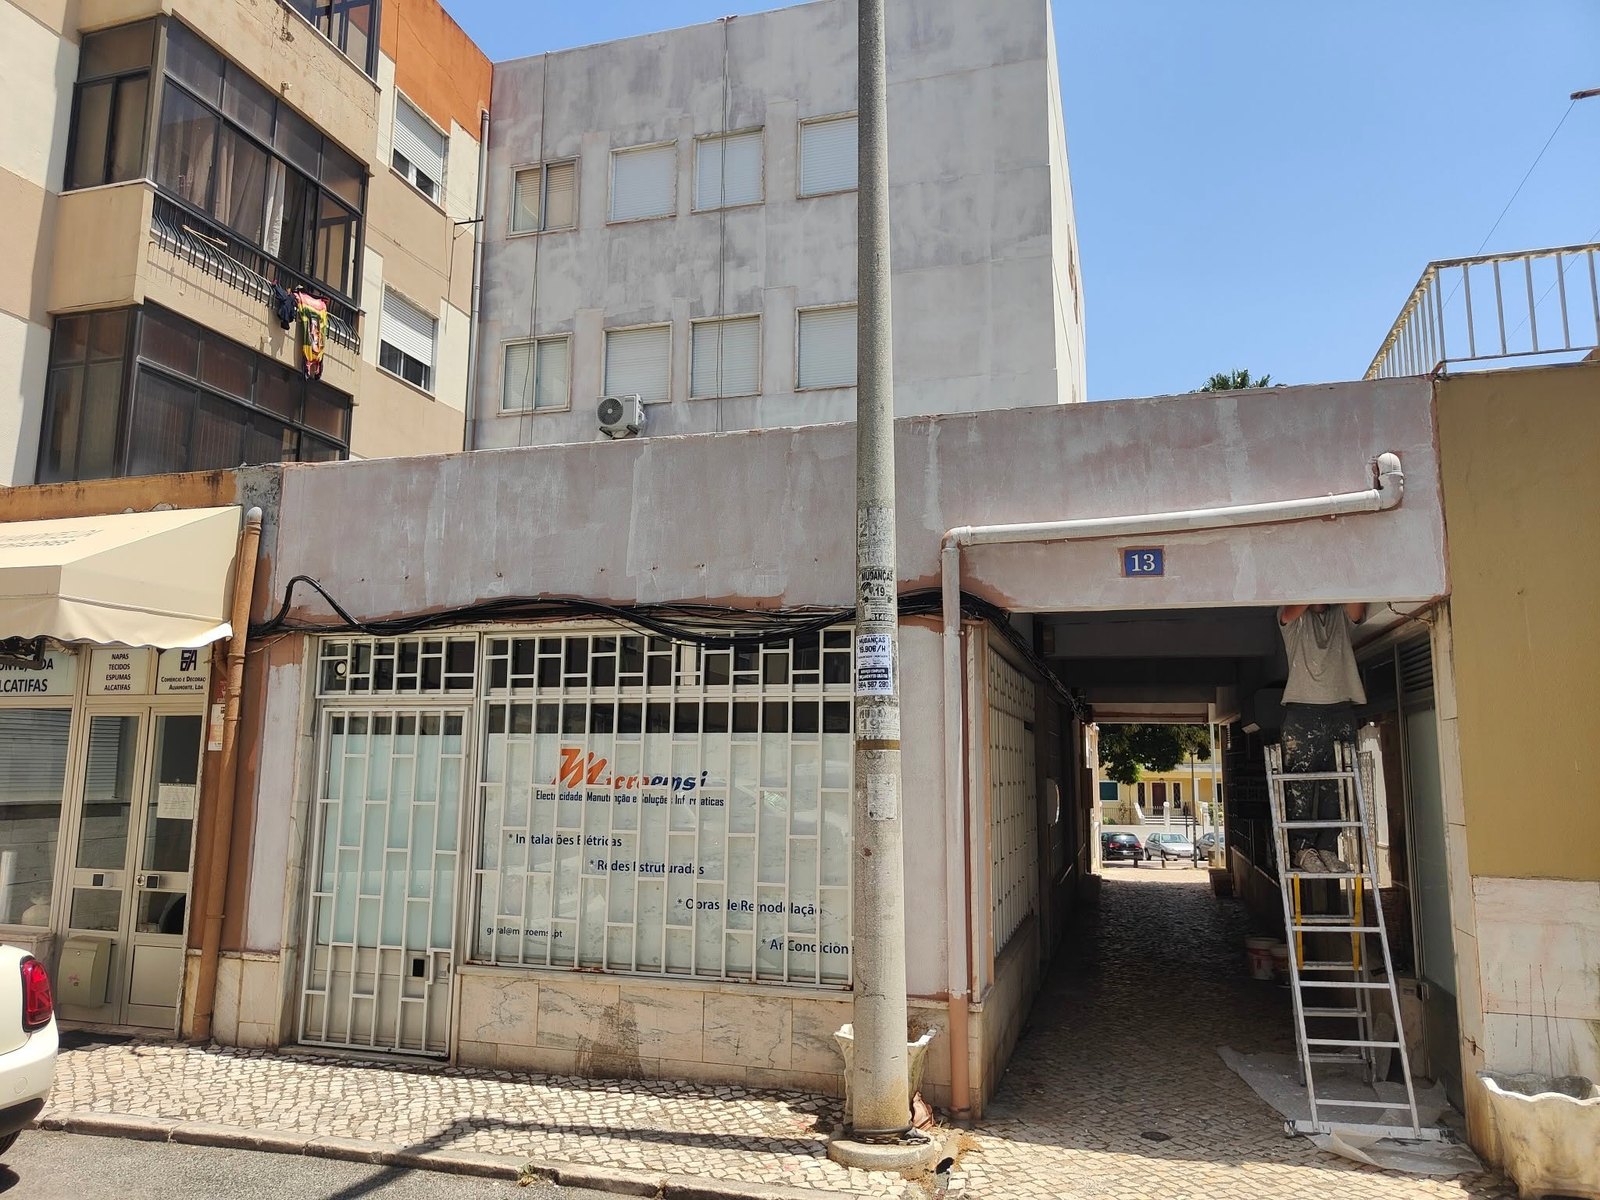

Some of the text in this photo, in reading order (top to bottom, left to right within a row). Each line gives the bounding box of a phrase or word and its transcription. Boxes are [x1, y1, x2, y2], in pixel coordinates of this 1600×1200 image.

[1131, 553, 1156, 572] 13
[108, 663, 131, 671] TECIDOS
[641, 794, 674, 806] oluçõe
[769, 939, 784, 950] Ar
